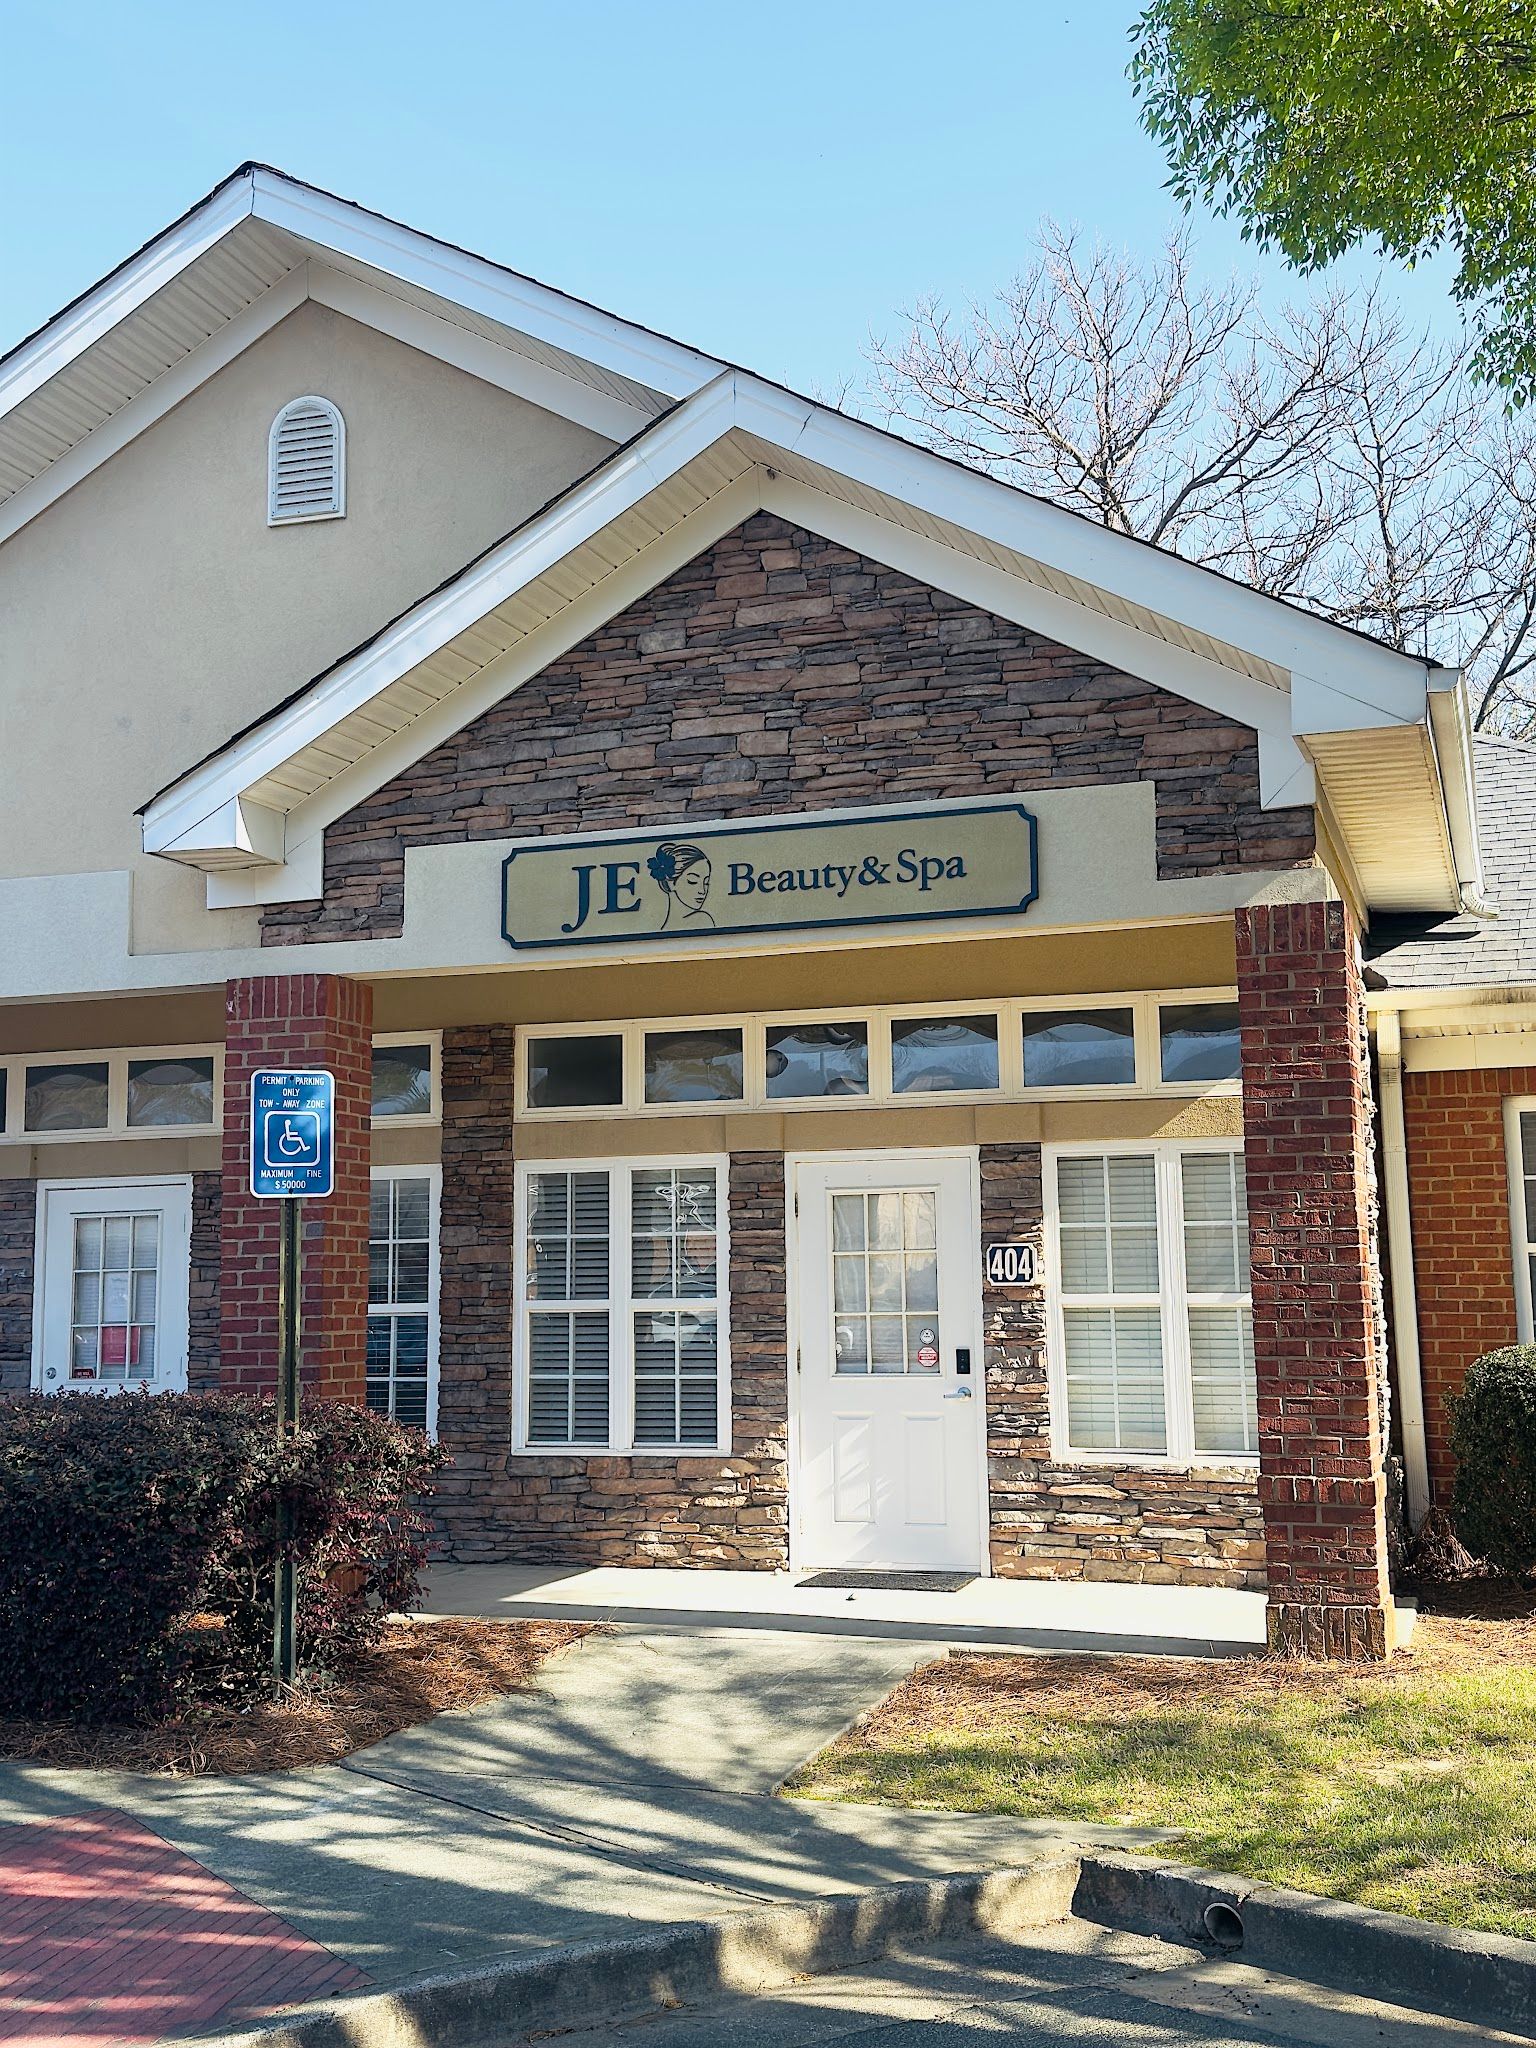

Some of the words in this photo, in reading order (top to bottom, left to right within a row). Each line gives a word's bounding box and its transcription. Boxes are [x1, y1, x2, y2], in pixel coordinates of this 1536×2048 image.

[561, 862, 641, 933] JE
[262, 1076, 287, 1085] PERMIT
[295, 1077, 325, 1086] PARKING
[282, 1088, 300, 1096] ONLY
[306, 1100, 325, 1109] ZONE
[260, 1169, 294, 1178] MAXIMUM
[306, 1169, 322, 1178] FINE
[991, 1248, 1032, 1281] 404
